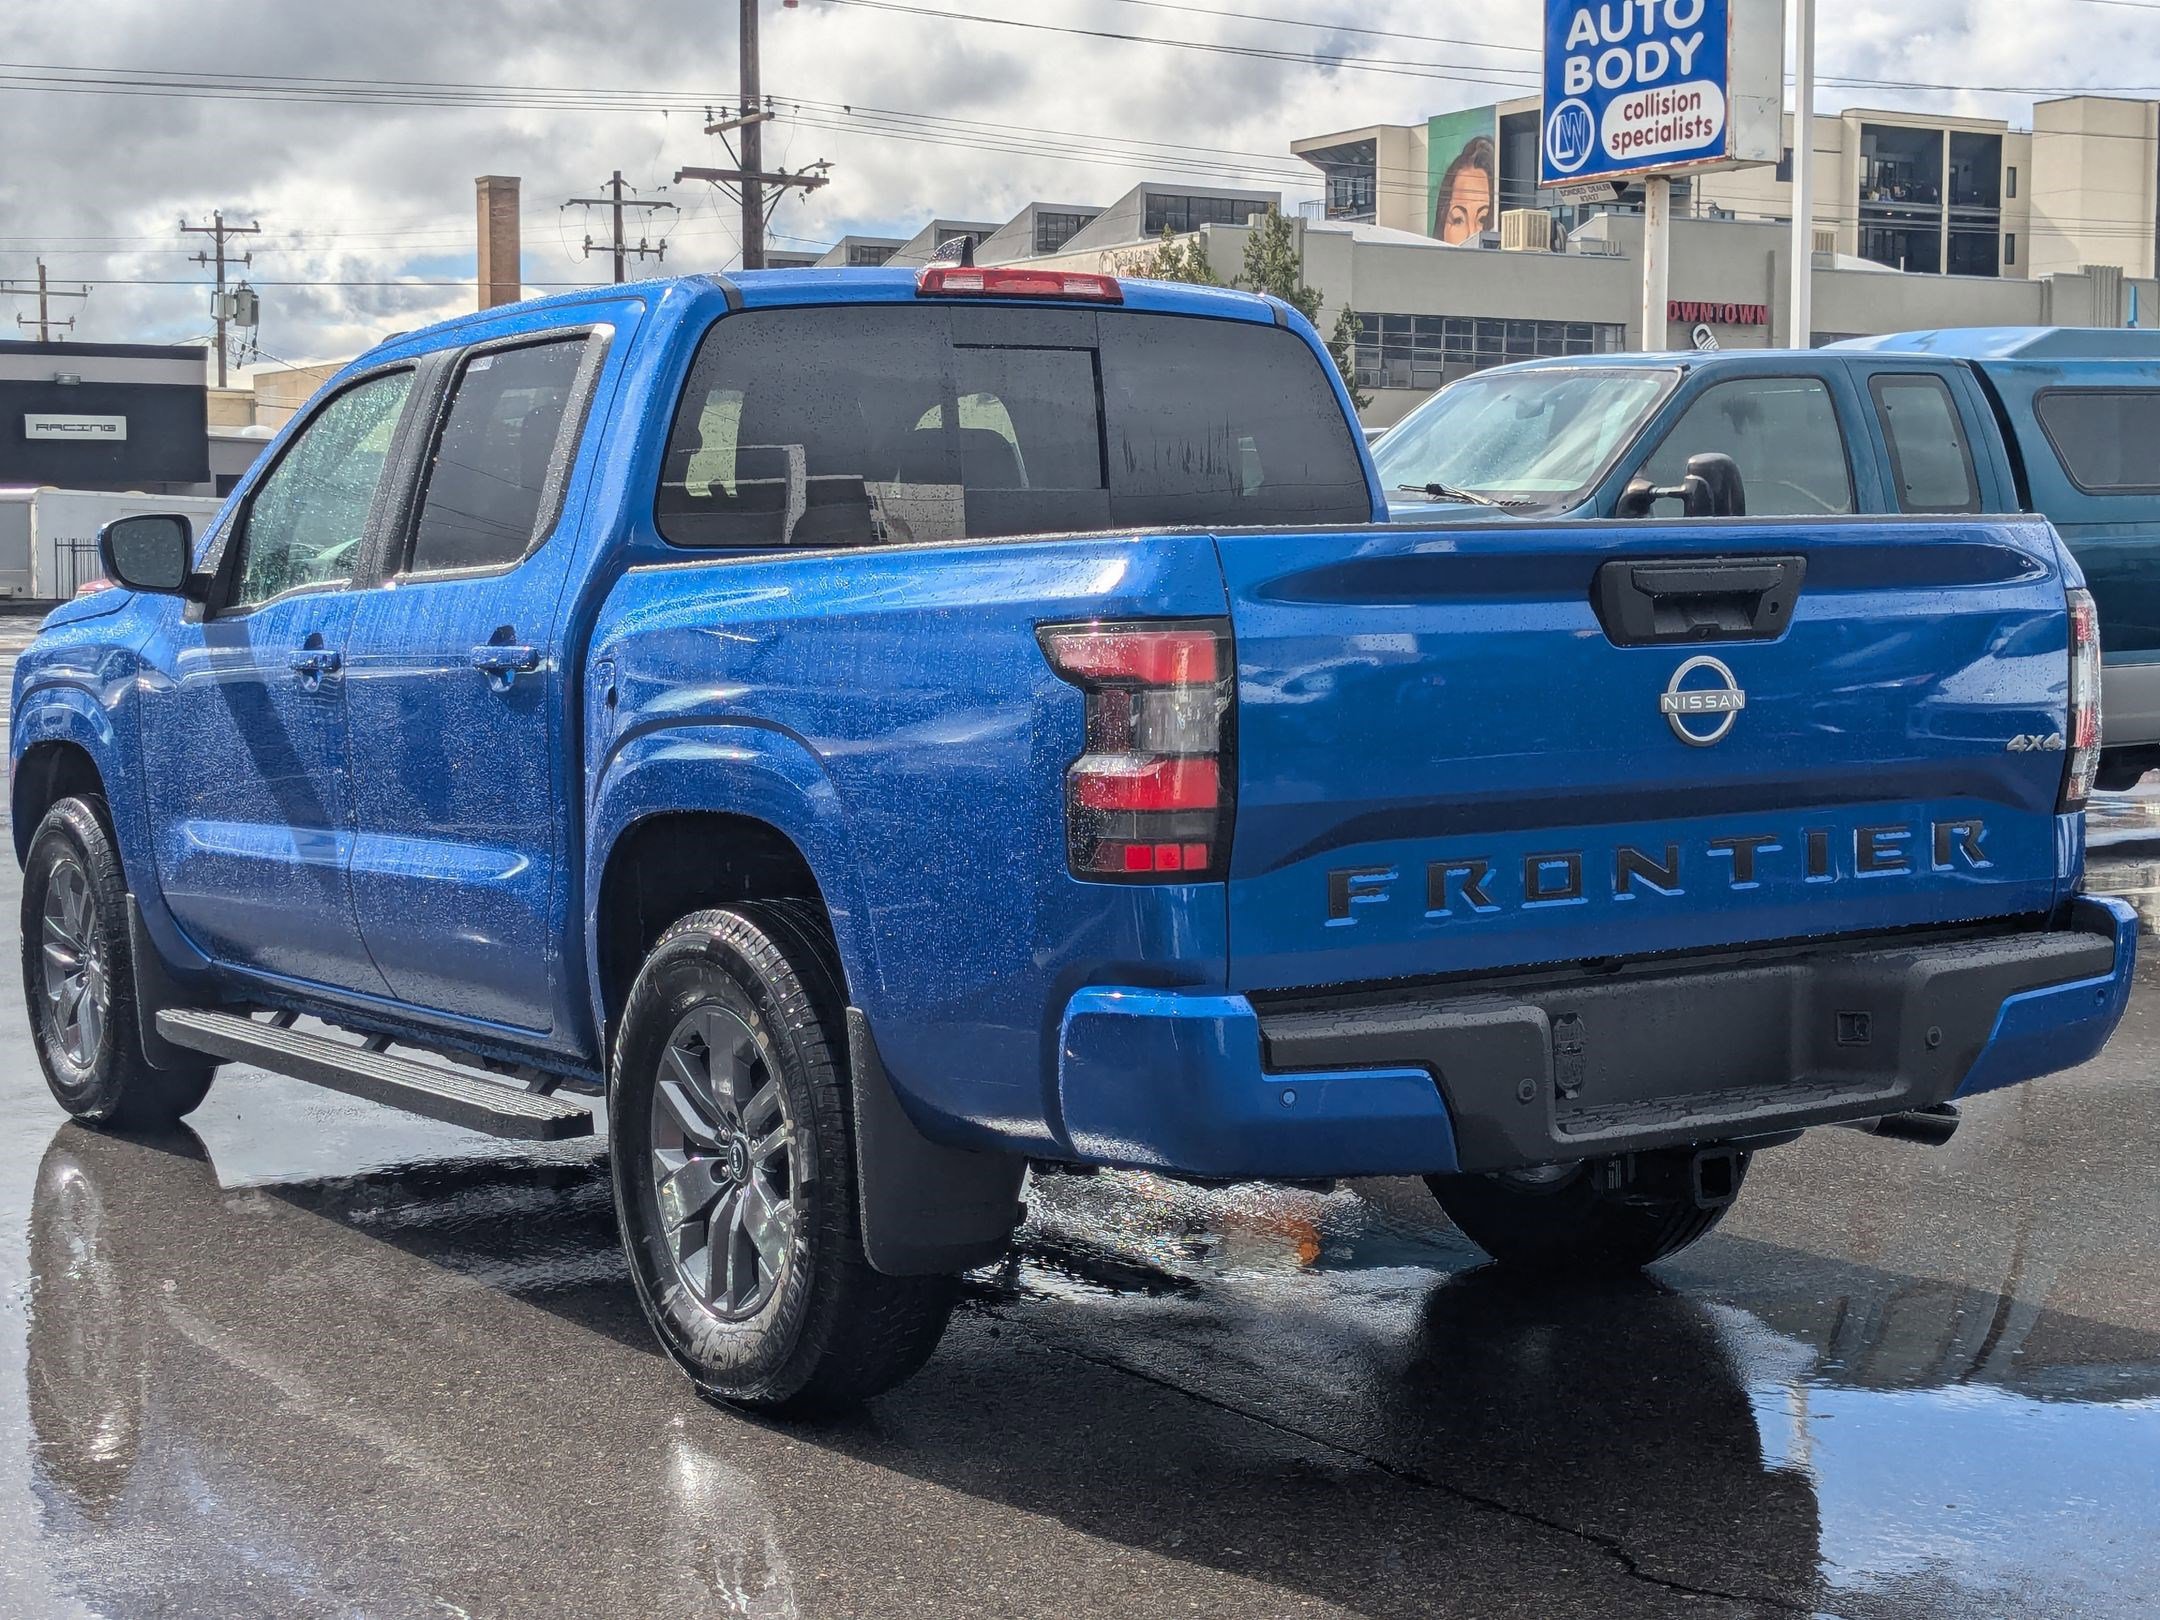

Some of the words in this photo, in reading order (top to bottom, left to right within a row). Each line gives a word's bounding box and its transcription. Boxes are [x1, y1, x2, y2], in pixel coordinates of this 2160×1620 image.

[1565, 0, 1704, 51] AUTO
[1564, 32, 1704, 96] BODY
[1623, 89, 1702, 122] collision
[1611, 115, 1713, 156] specialists
[1587, 183, 1611, 193] DEALER
[35, 423, 117, 432] RACING
[1664, 694, 1744, 710] NISSAN
[1325, 819, 1994, 926] FRONTIER
